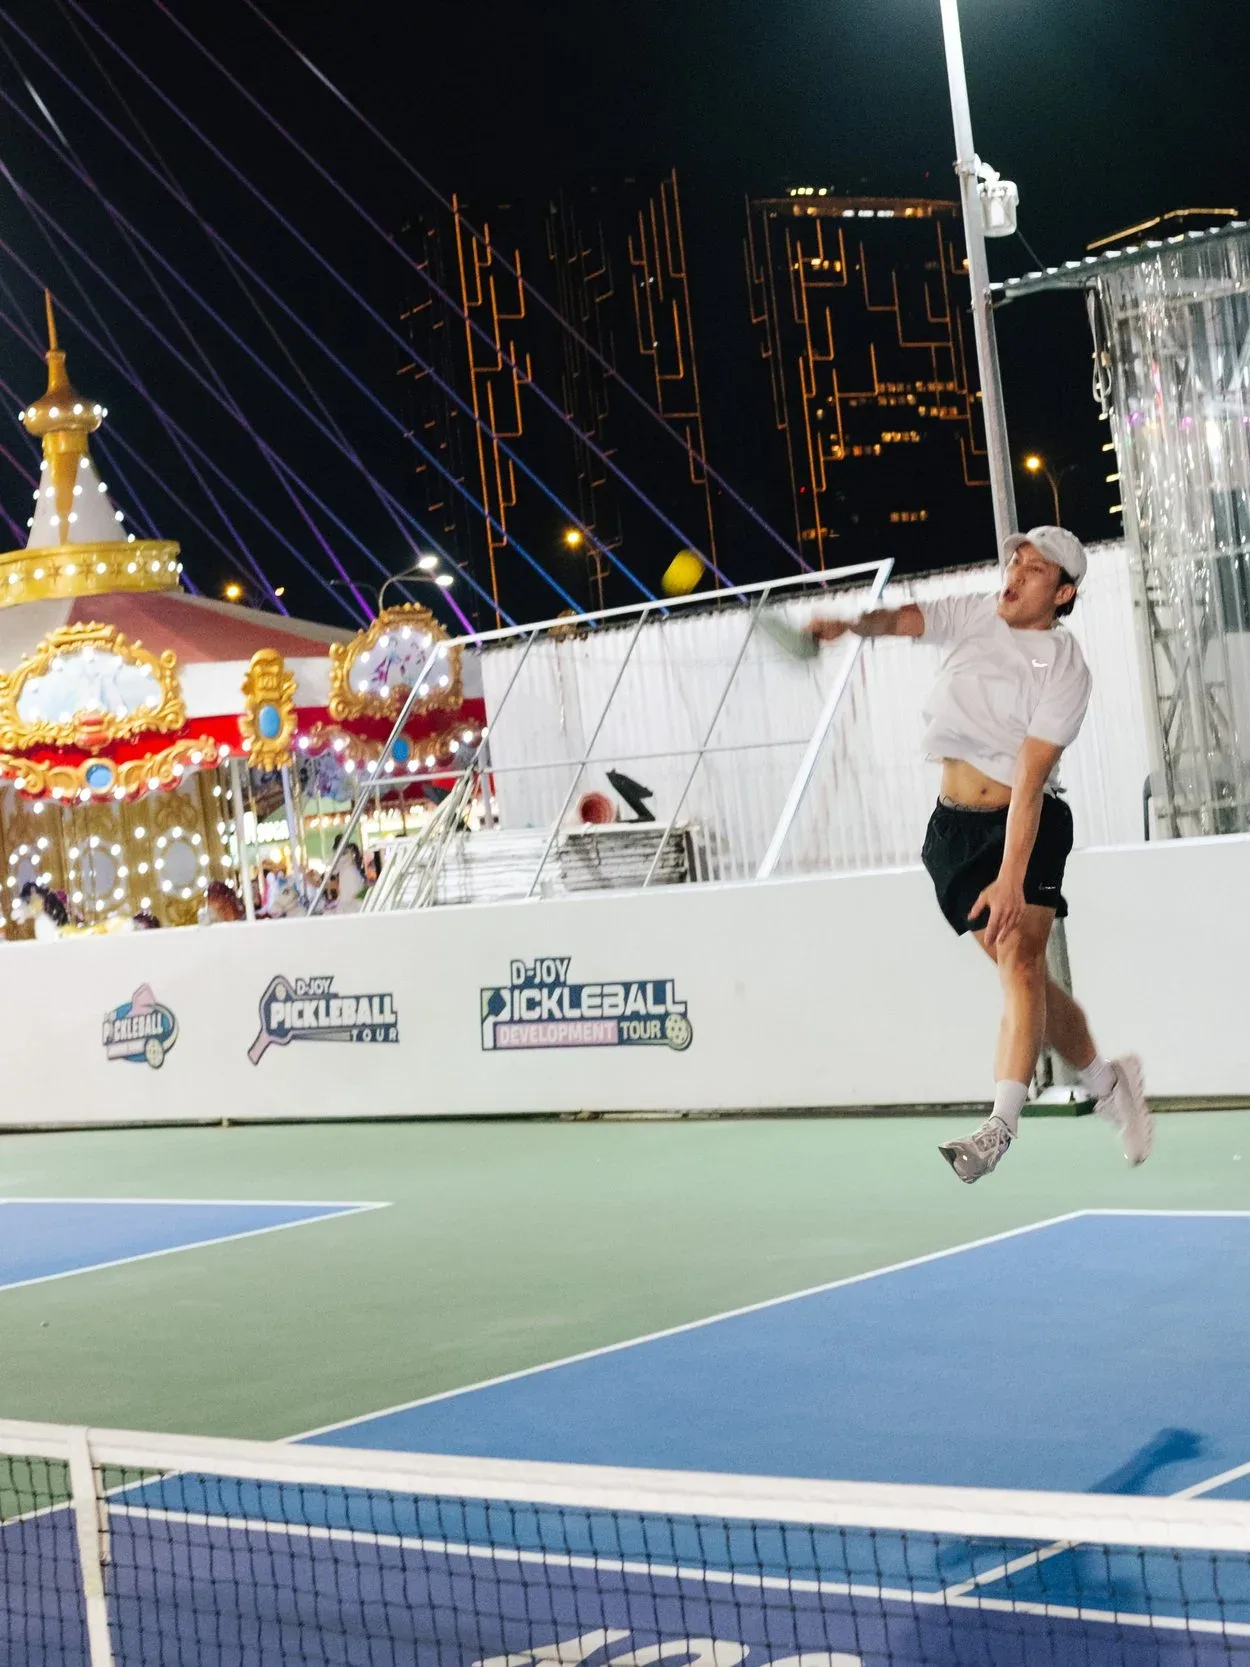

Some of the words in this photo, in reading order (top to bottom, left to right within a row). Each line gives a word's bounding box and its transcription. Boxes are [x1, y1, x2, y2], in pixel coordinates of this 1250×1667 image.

[511, 957, 570, 986] D-JOY
[295, 977, 334, 996] D-JOY
[270, 995, 396, 1030] PICKLEBALL
[482, 981, 687, 1024] PICKLEBALL
[351, 1027, 397, 1042] TOUR
[500, 1022, 615, 1045] DEVELOPMENT
[620, 1019, 662, 1040] TOUR
